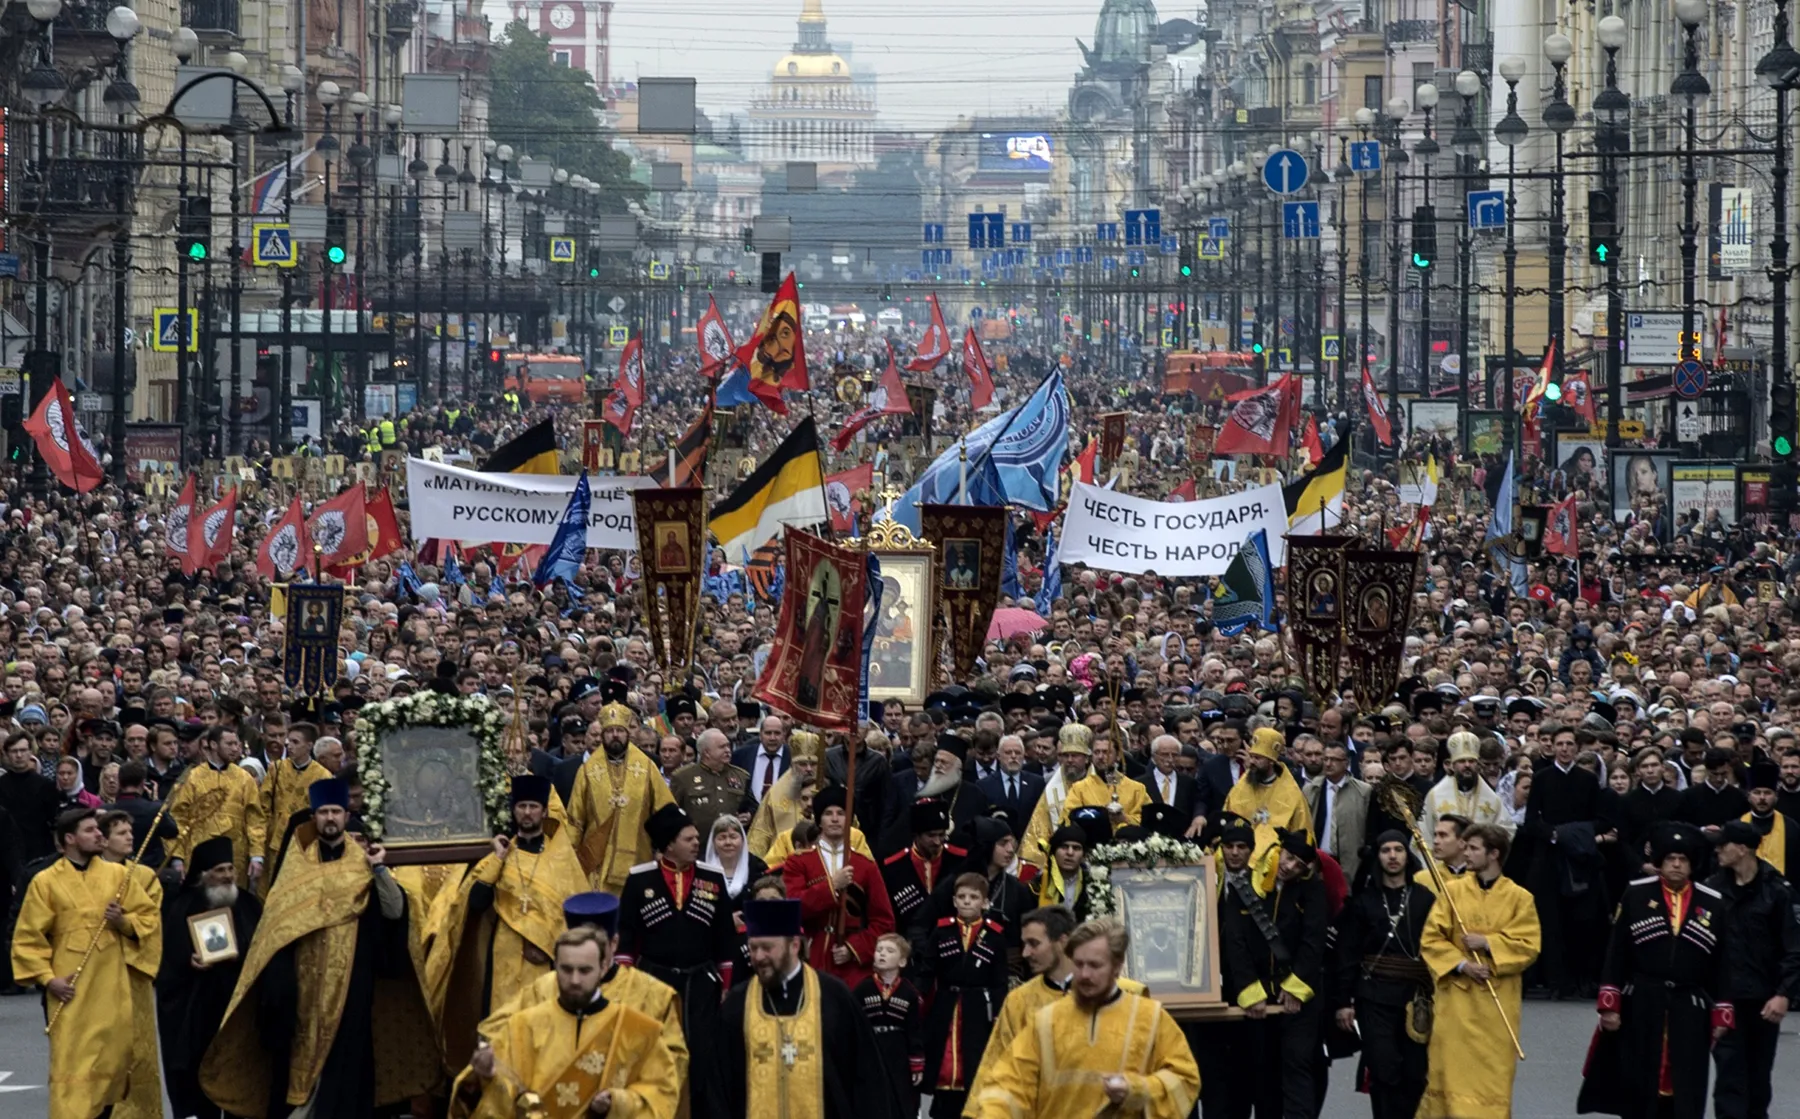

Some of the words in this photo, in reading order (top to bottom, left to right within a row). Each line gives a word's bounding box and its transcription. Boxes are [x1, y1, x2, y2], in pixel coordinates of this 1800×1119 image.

[453, 505, 559, 525] РУССКОМУ
[1084, 497, 1146, 528] ЧЕСТЬ
[1154, 502, 1269, 531] ГОСУДАРЯ-
[1088, 535, 1158, 560] ЧЕСТЬ
[1166, 541, 1240, 561] НАРОД
